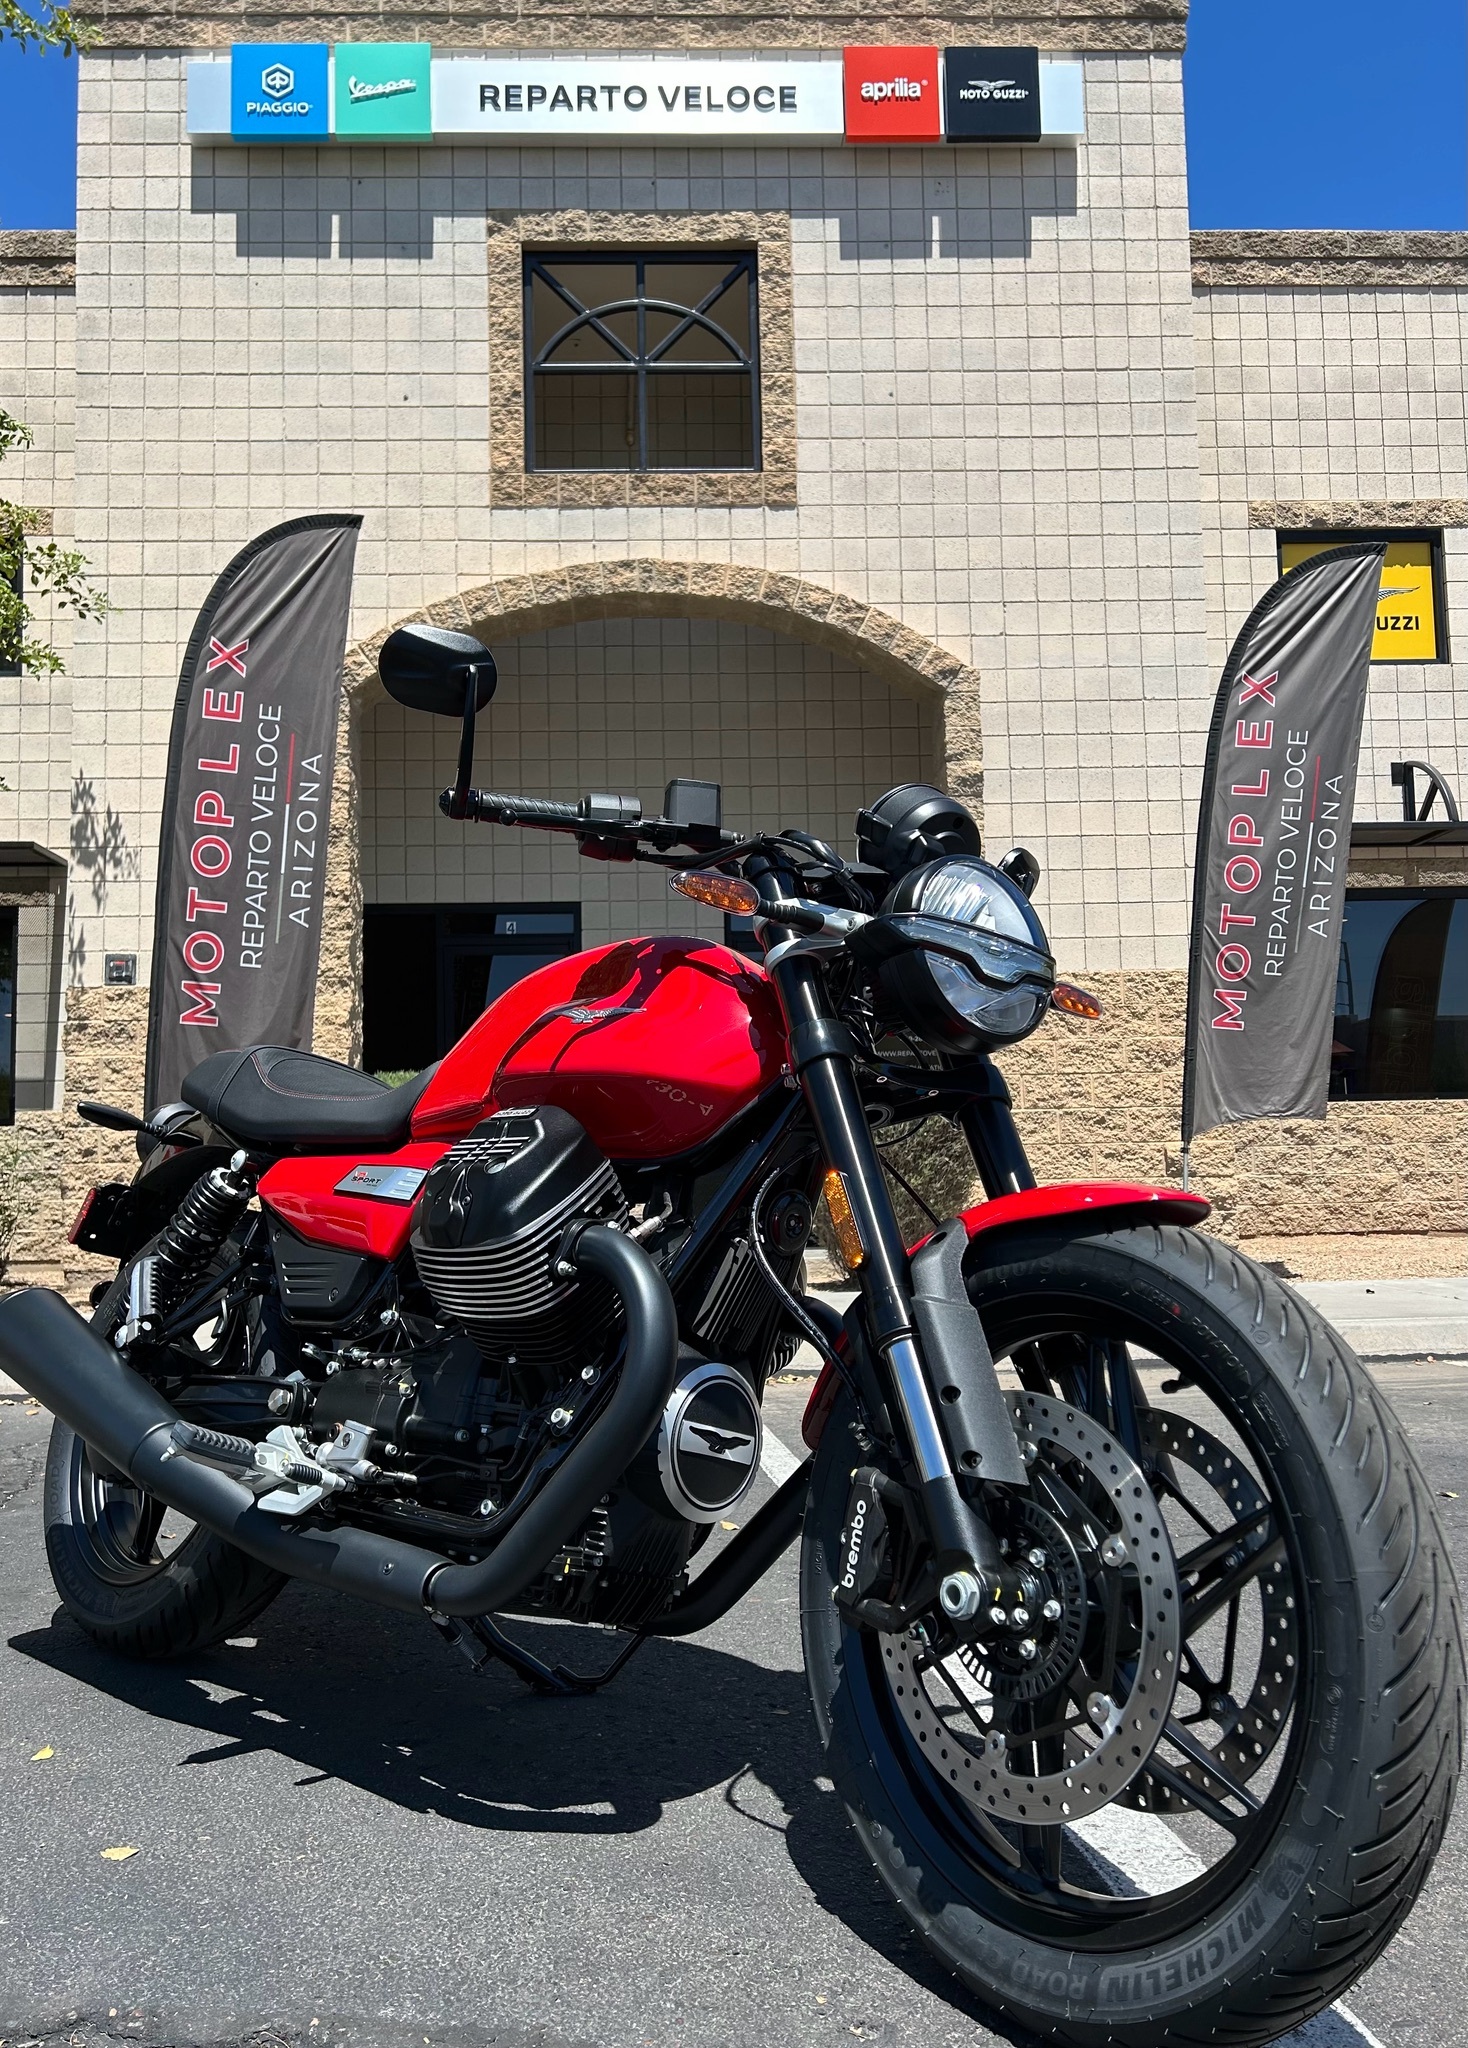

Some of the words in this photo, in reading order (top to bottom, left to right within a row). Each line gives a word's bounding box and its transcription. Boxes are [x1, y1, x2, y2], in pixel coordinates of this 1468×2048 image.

[246, 102, 309, 113] PIAGGIO
[349, 75, 416, 99] Vespa
[479, 84, 647, 112] REPARTO
[658, 85, 798, 113] VELOCE
[861, 78, 921, 100] aprilia
[959, 89, 990, 99] MOTO
[992, 89, 1025, 99] GUZZI
[1376, 615, 1420, 631] UZZI
[250, 703, 282, 822] VELOCE
[1279, 729, 1309, 842] VELOCE
[179, 635, 250, 1028] MOTOPLEX
[288, 753, 323, 928] ARIZONA
[1211, 670, 1280, 1032] MOTOPLEX
[1307, 774, 1344, 938] ARIZONA
[240, 829, 273, 969] REPARTO
[507, 922, 516, 935] 4
[1263, 847, 1298, 977] REPARTO
[841, 1500, 867, 1589] brembo
[1011, 1959, 1088, 2000] ROAD
[1106, 1897, 1266, 2003] MICHELIN
